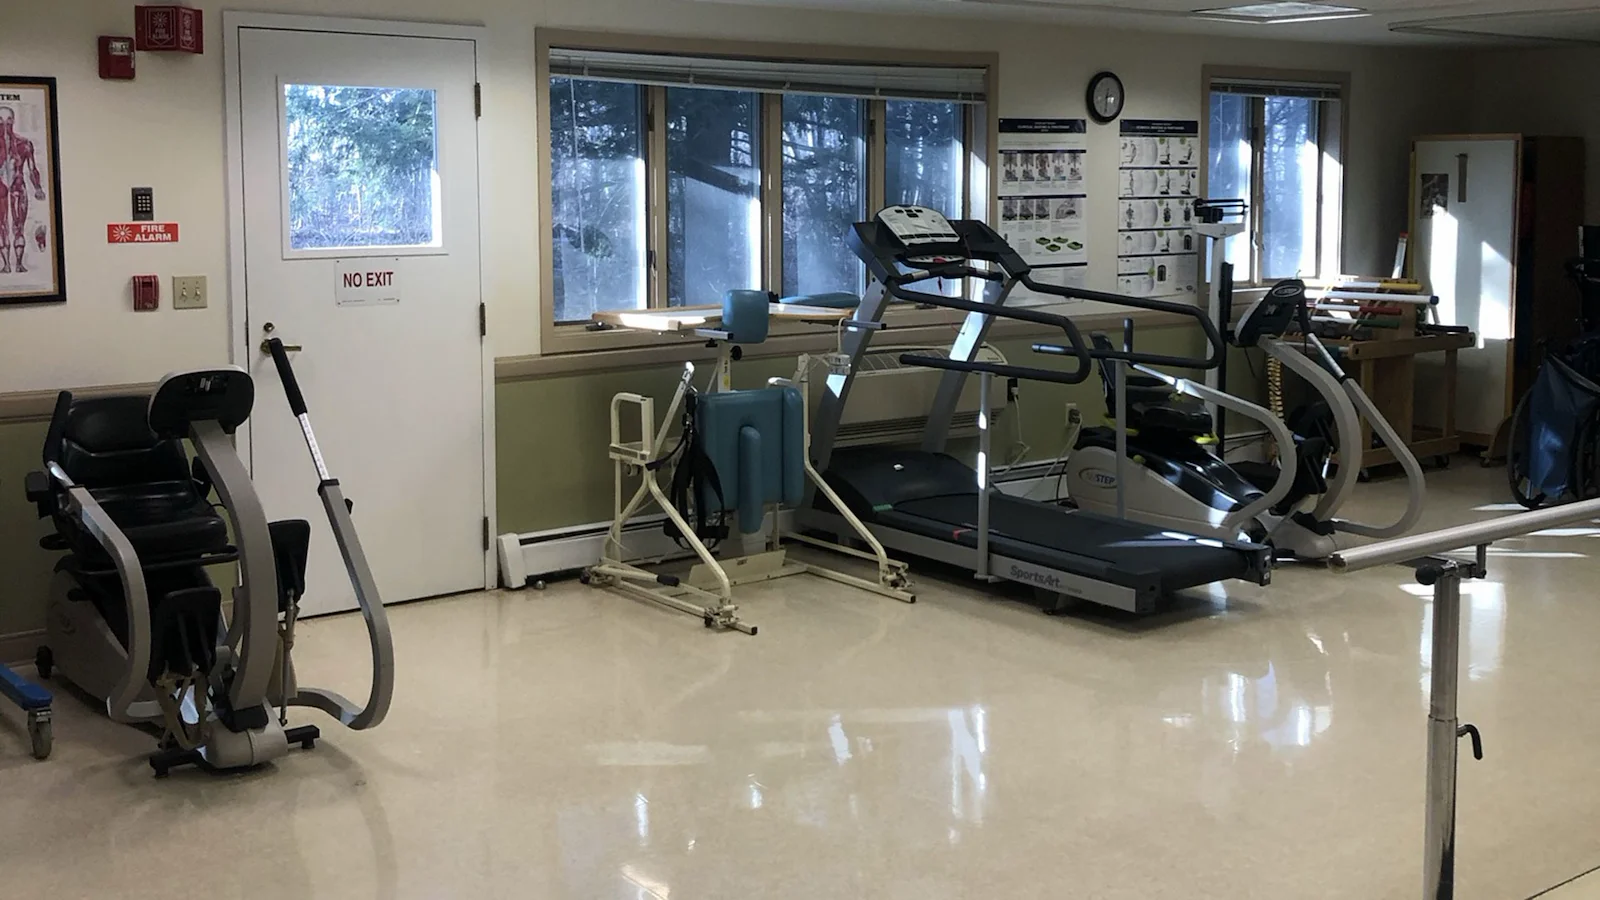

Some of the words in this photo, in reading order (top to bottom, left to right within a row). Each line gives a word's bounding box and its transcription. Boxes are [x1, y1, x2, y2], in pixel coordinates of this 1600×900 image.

[141, 224, 165, 233] FIRE
[134, 233, 172, 241] ALARM
[343, 272, 363, 288] NO
[366, 271, 394, 287] EXIT
[1010, 564, 1060, 588] SportsArt
